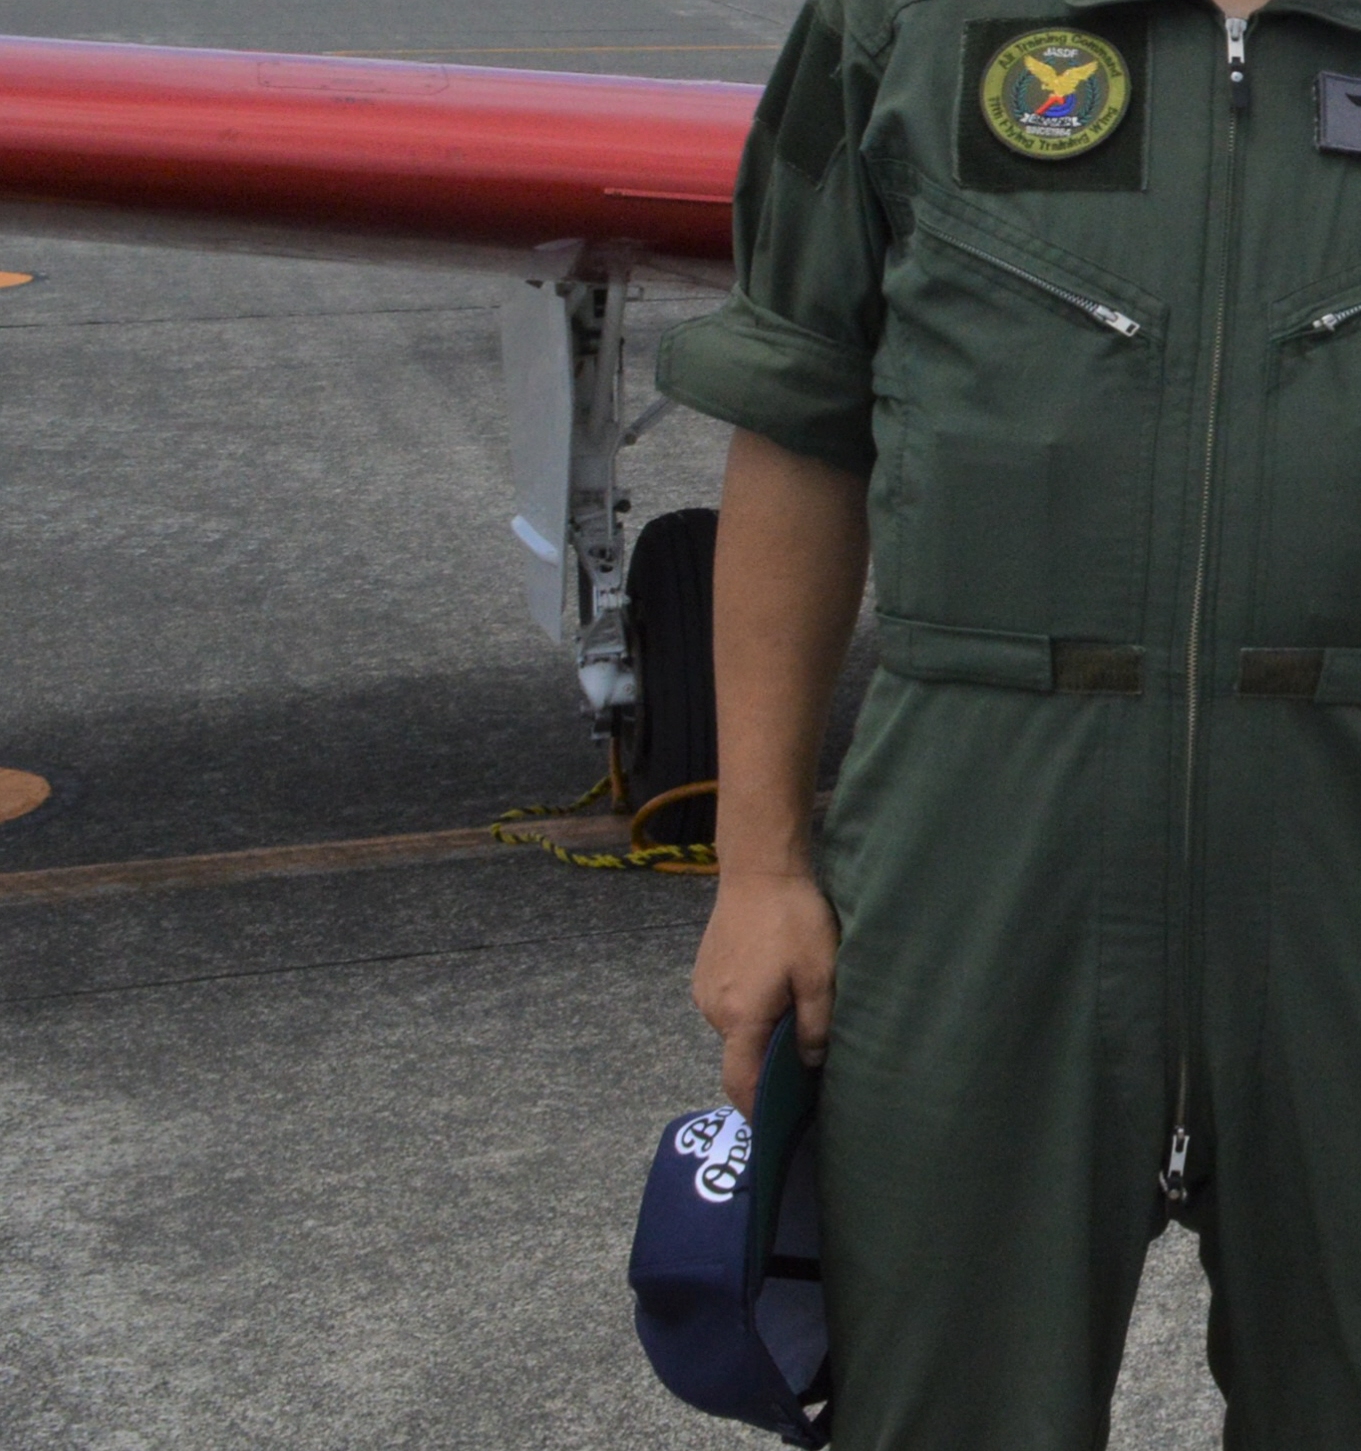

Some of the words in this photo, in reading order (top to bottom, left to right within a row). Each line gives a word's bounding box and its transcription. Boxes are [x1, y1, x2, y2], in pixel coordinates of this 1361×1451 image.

[1015, 34, 1067, 52] Training
[1072, 34, 1122, 78] Command
[1043, 47, 1079, 58] JASDF
[1039, 133, 1091, 151] Training
[1090, 106, 1118, 134] Wing
[681, 1108, 735, 1153] Ba
[702, 1122, 752, 1195] Ope
